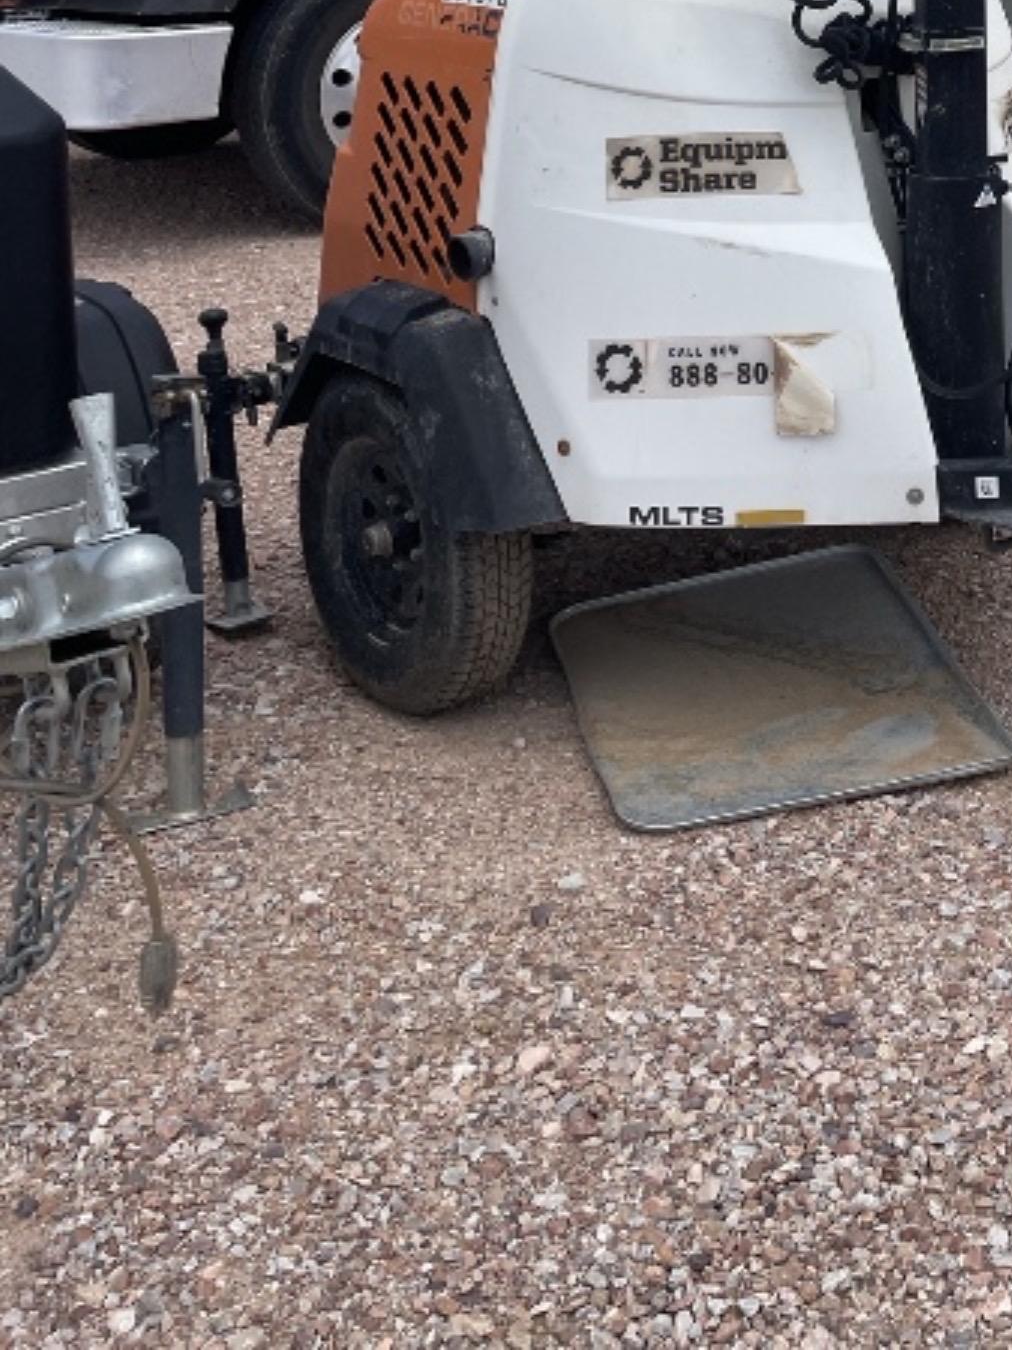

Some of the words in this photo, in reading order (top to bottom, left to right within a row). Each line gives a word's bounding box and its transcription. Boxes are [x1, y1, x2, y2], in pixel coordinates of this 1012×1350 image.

[659, 168, 757, 193] Share
[668, 347, 703, 358] CALL
[669, 362, 775, 388] 888-80
[628, 506, 724, 527] MLTS
